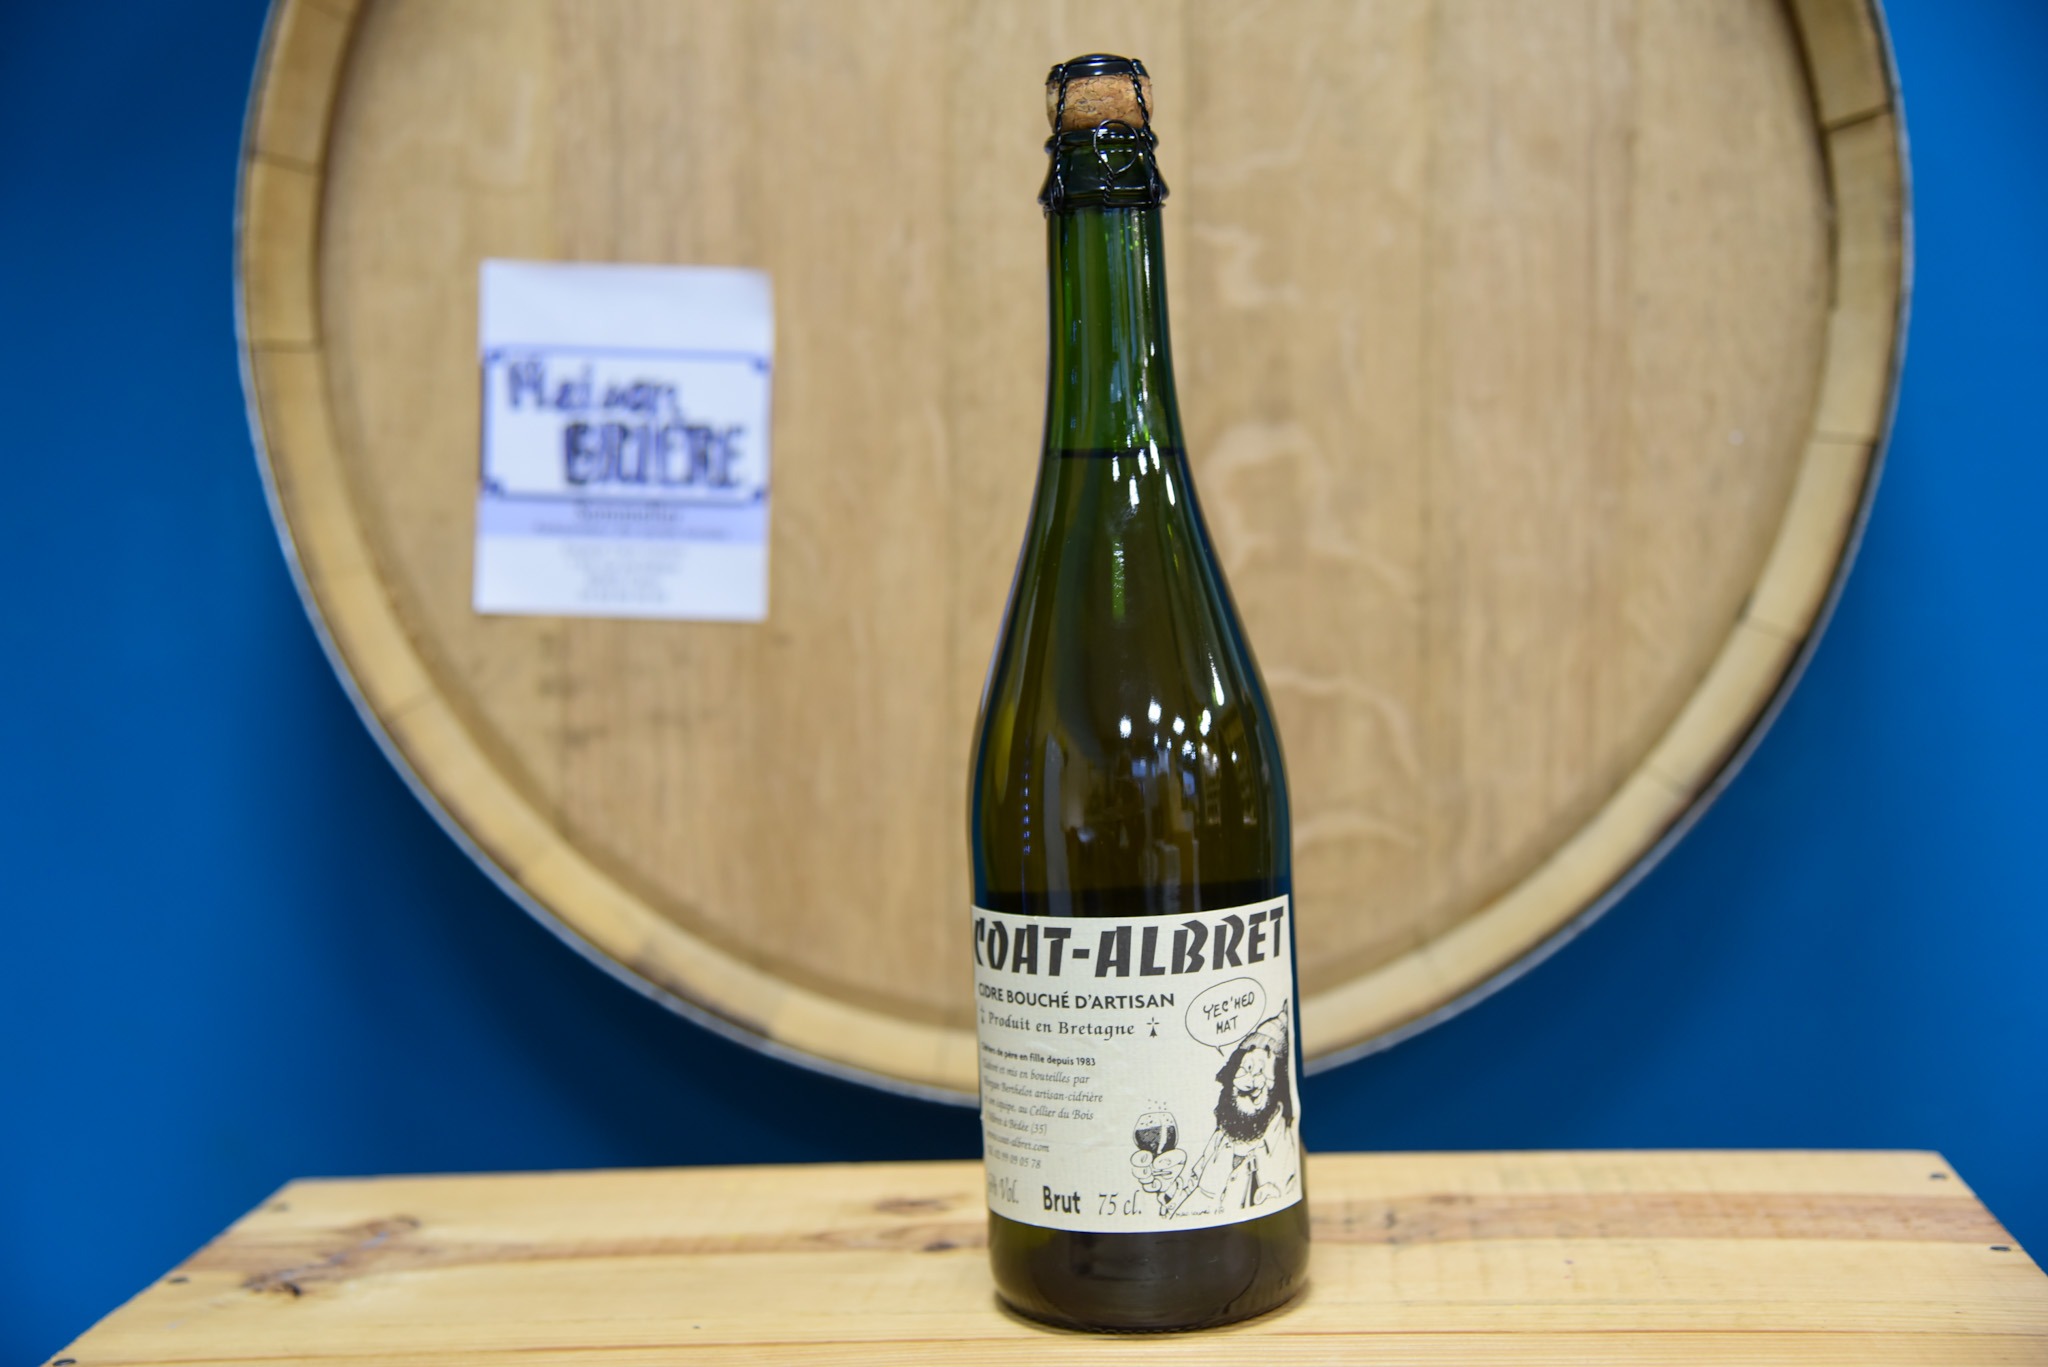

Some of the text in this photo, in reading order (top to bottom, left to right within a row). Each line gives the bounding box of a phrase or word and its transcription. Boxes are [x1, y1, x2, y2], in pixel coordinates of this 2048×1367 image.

[974, 906, 1285, 978] COAT-ALBRET
[979, 982, 1176, 1011] CIDRE BOUCHÉ D'ARTISAN
[1202, 991, 1256, 1021] YEC'HED
[988, 1011, 1136, 1042] Produit en Bretagne
[1029, 1052, 1046, 1064] fille
[1046, 1055, 1075, 1067] depuis
[1075, 1057, 1097, 1067] 1983
[1030, 1069, 1071, 1084] bouteilles
[1073, 1076, 1091, 1088] par
[1034, 1089, 1104, 1103] artisan-cidrière
[1029, 1105, 1056, 1118] Cellier
[1057, 1107, 1071, 1119] du
[1072, 1109, 1095, 1121] Bois
[1031, 1158, 1042, 1170] 78
[1000, 1177, 1020, 1204] Vol.
[1042, 1185, 1082, 1214] Brut
[1098, 1192, 1119, 1216] 75
[1123, 1189, 1143, 1216] cl.
